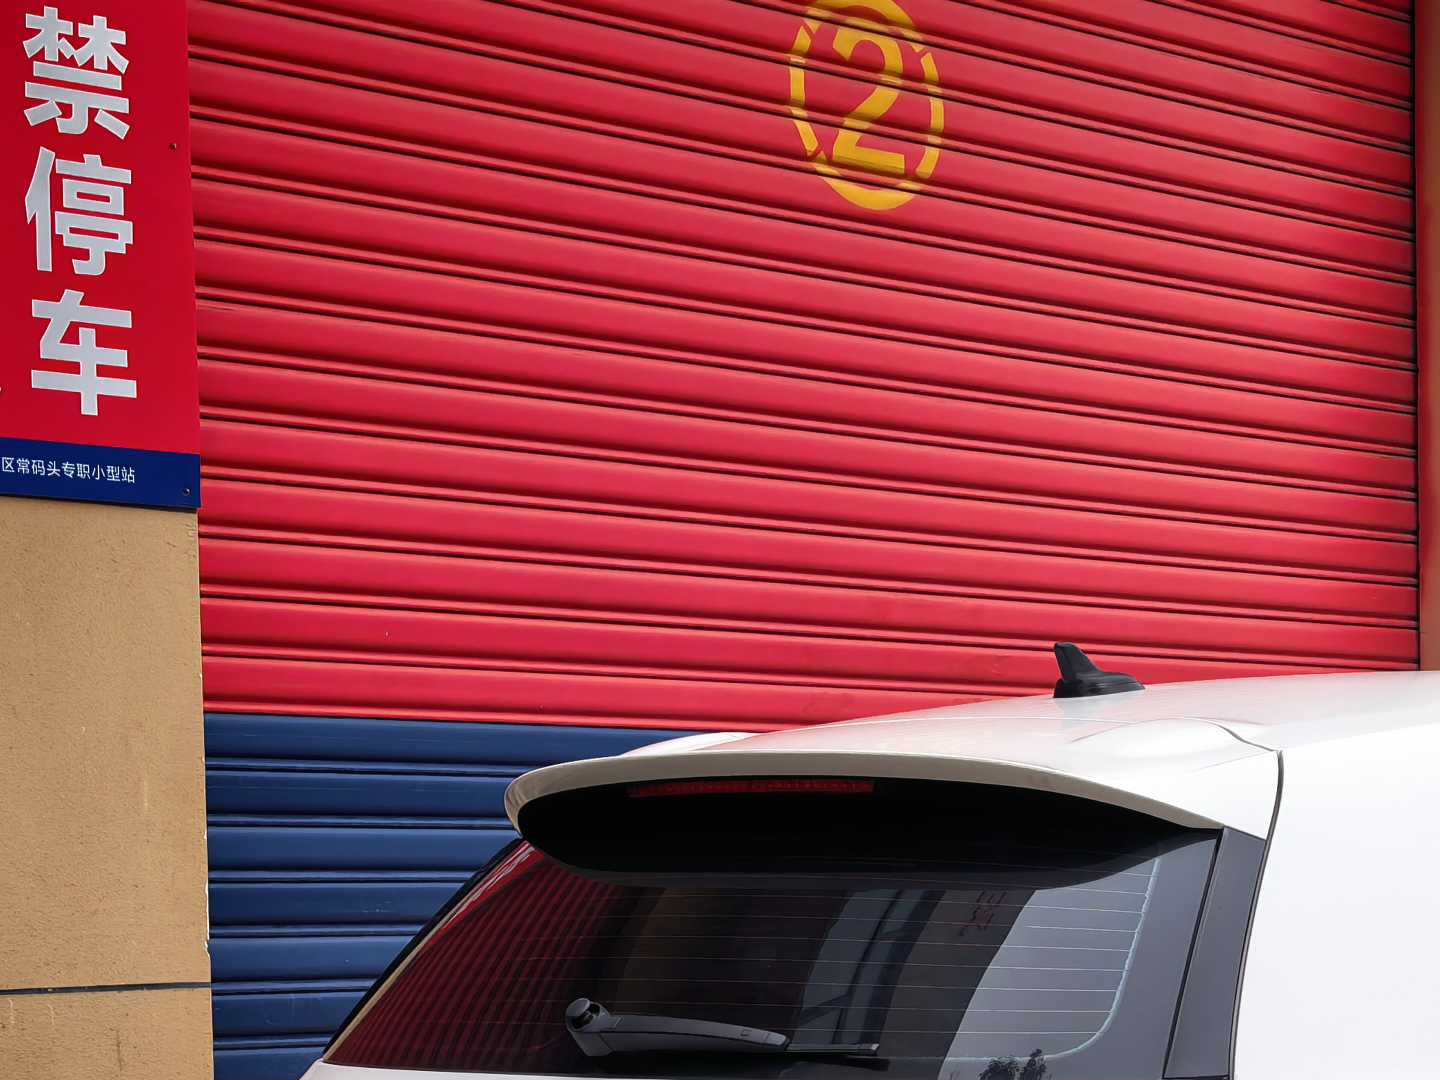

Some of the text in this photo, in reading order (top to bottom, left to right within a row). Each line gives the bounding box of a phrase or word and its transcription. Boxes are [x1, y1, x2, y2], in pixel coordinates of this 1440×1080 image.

[22, 5, 138, 417] 禁停车
[1, 456, 136, 484] 区常码头专职小型站
